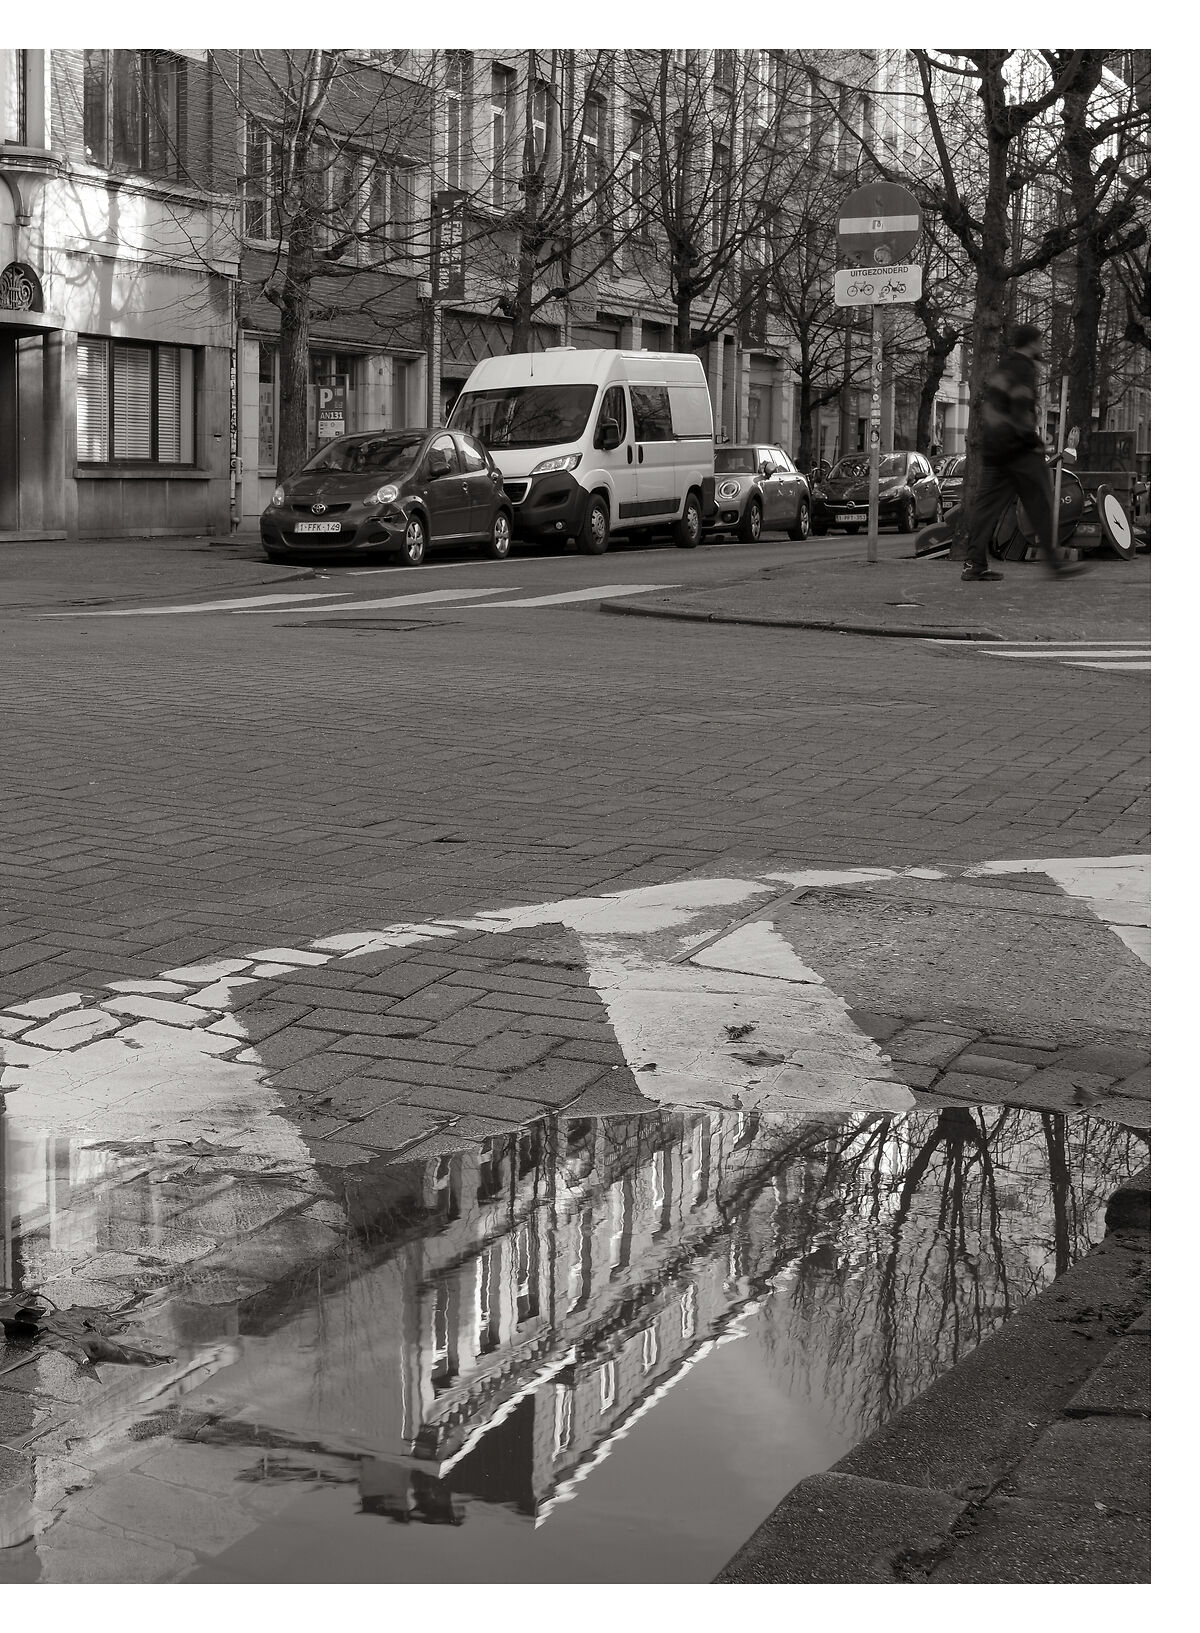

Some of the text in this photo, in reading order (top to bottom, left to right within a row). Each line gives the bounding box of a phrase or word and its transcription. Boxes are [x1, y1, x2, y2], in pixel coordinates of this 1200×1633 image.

[850, 267, 909, 277] UITGEZONDERD
[320, 388, 334, 409] P
[320, 412, 343, 420] AN131
